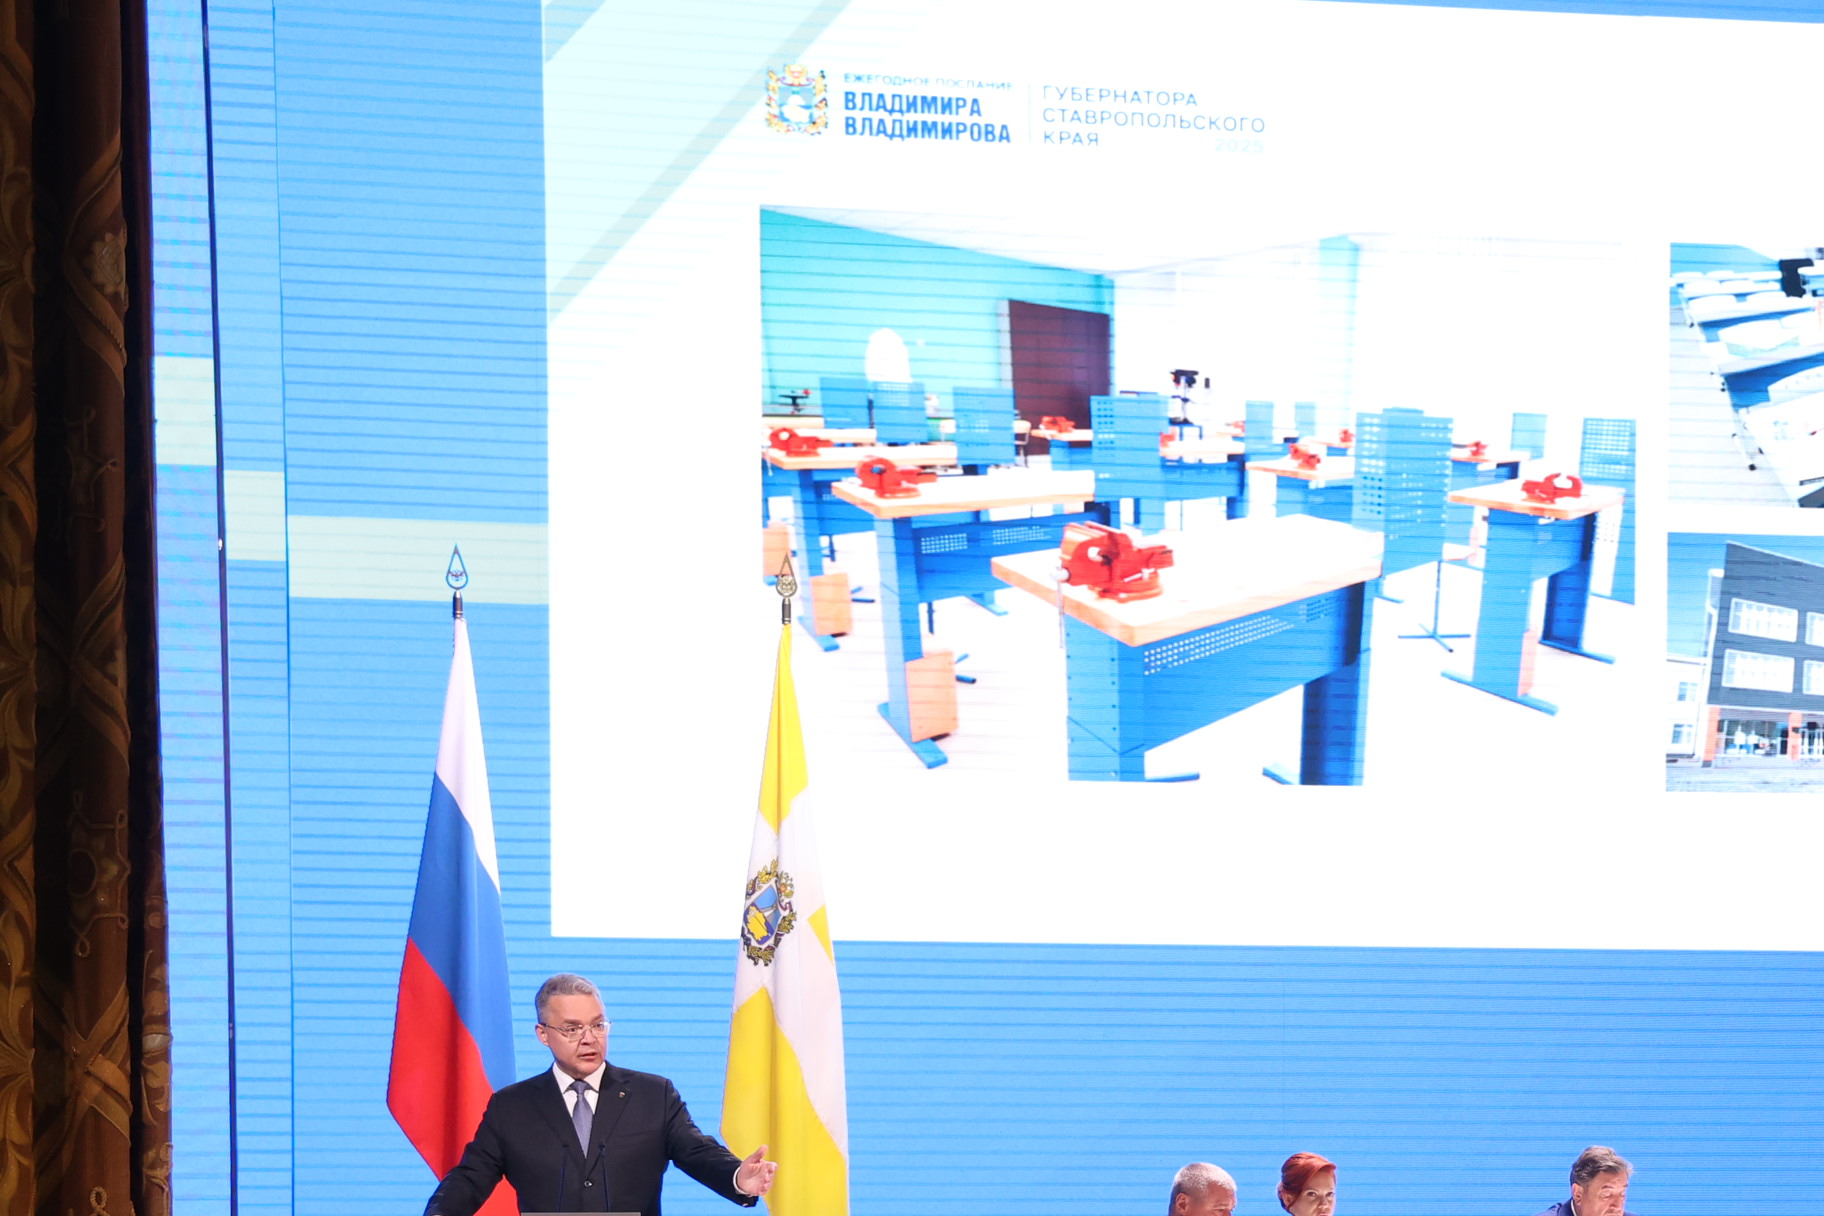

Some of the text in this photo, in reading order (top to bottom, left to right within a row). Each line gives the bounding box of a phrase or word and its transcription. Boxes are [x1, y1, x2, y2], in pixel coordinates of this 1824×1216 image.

[843, 73, 1014, 91] ЕЖЕГОДНОЕ ПОСЛАНИЕ
[843, 90, 982, 117] ВЛАДИМИРА
[1043, 85, 1198, 107] ГУБЕРНАТОРА
[844, 116, 1012, 144] ВЛАДИМИРОВА
[1042, 108, 1265, 133] СТАВРОПОЛЬСКОГО
[1044, 130, 1099, 147] КРАЯ
[1214, 138, 1264, 154] 2025
